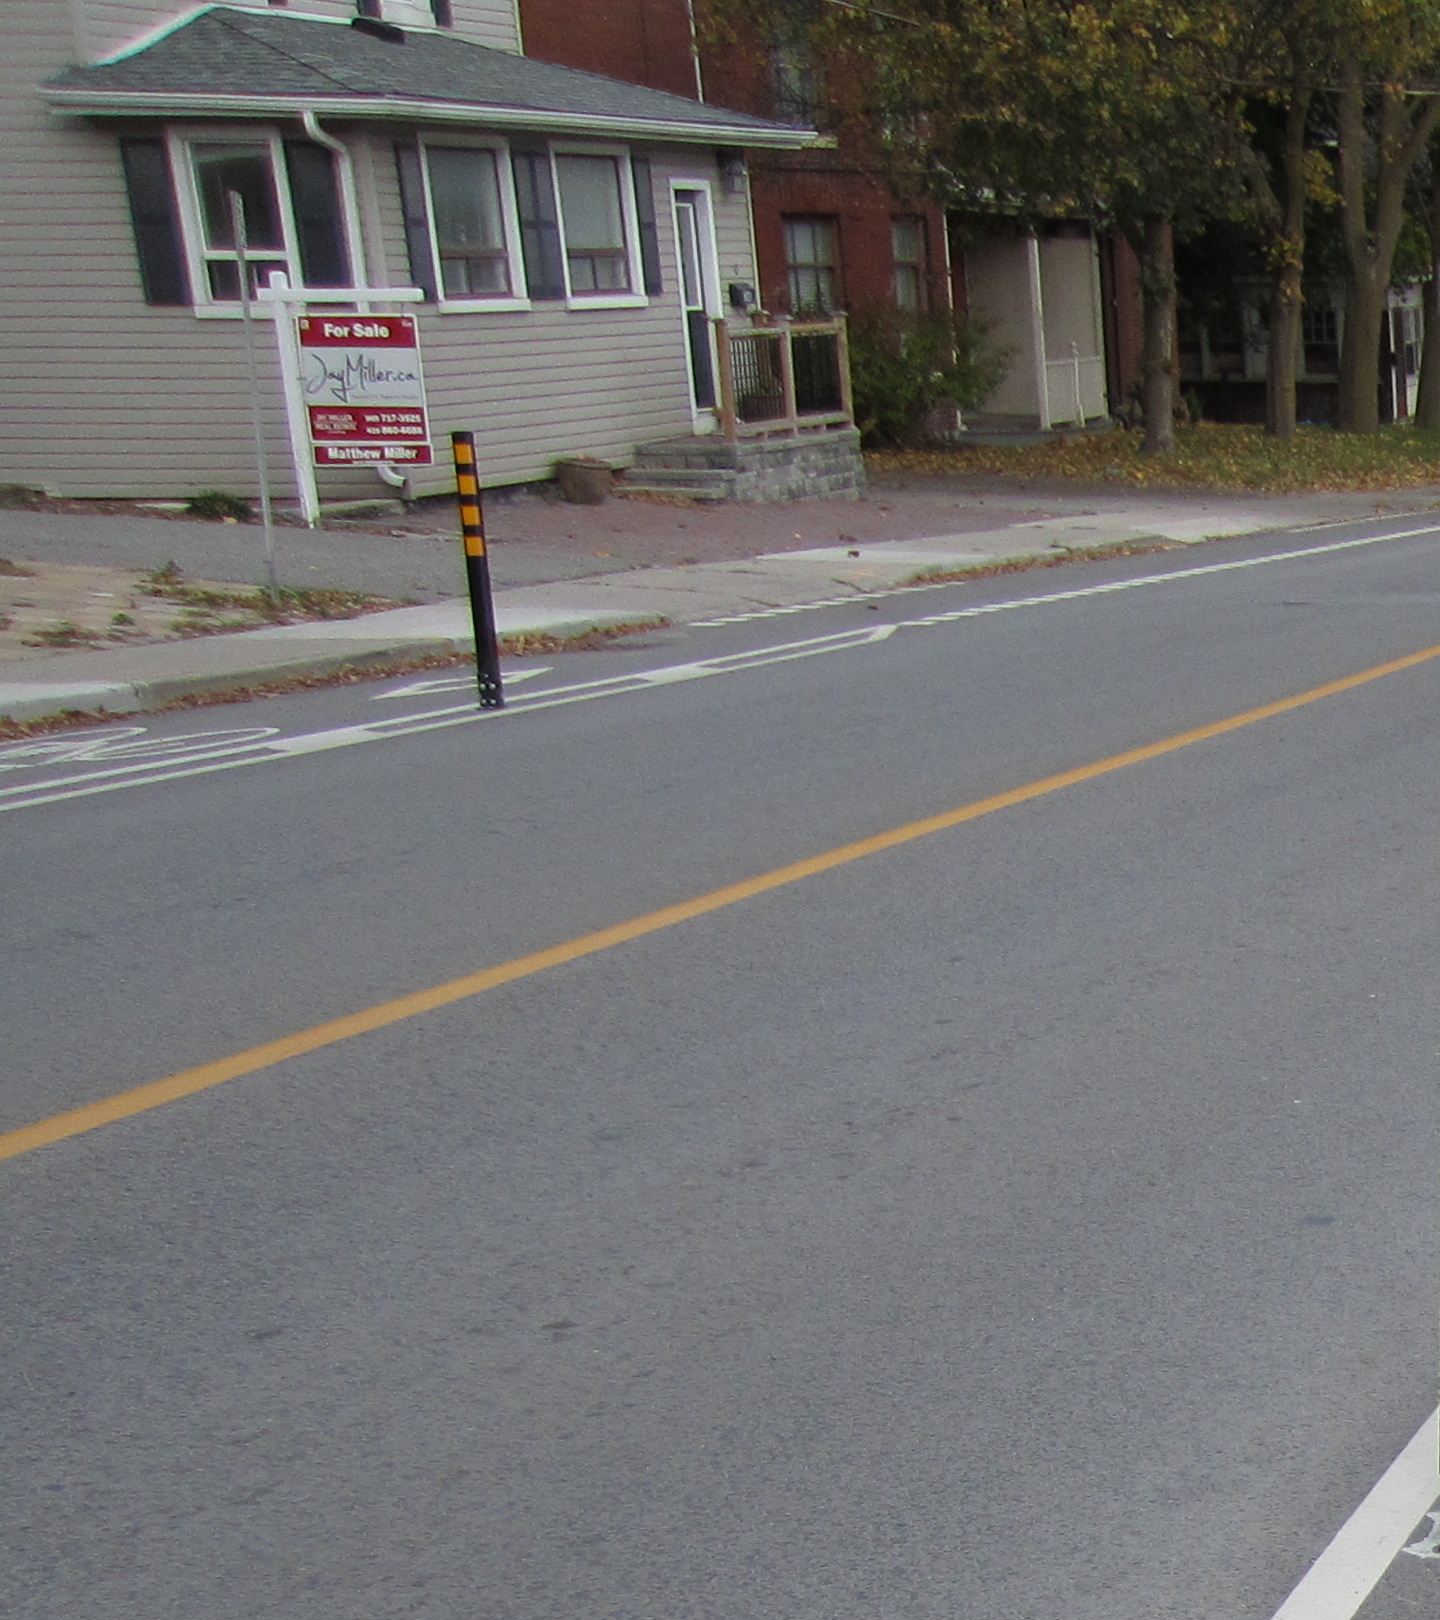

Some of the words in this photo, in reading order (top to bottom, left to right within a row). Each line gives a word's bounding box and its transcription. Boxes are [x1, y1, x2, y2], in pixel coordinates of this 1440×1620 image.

[323, 322, 350, 338] For
[352, 323, 390, 338] Sale
[306, 353, 419, 403] JayMiller.ca
[327, 446, 381, 460] Matthew
[384, 446, 418, 460] Miller
